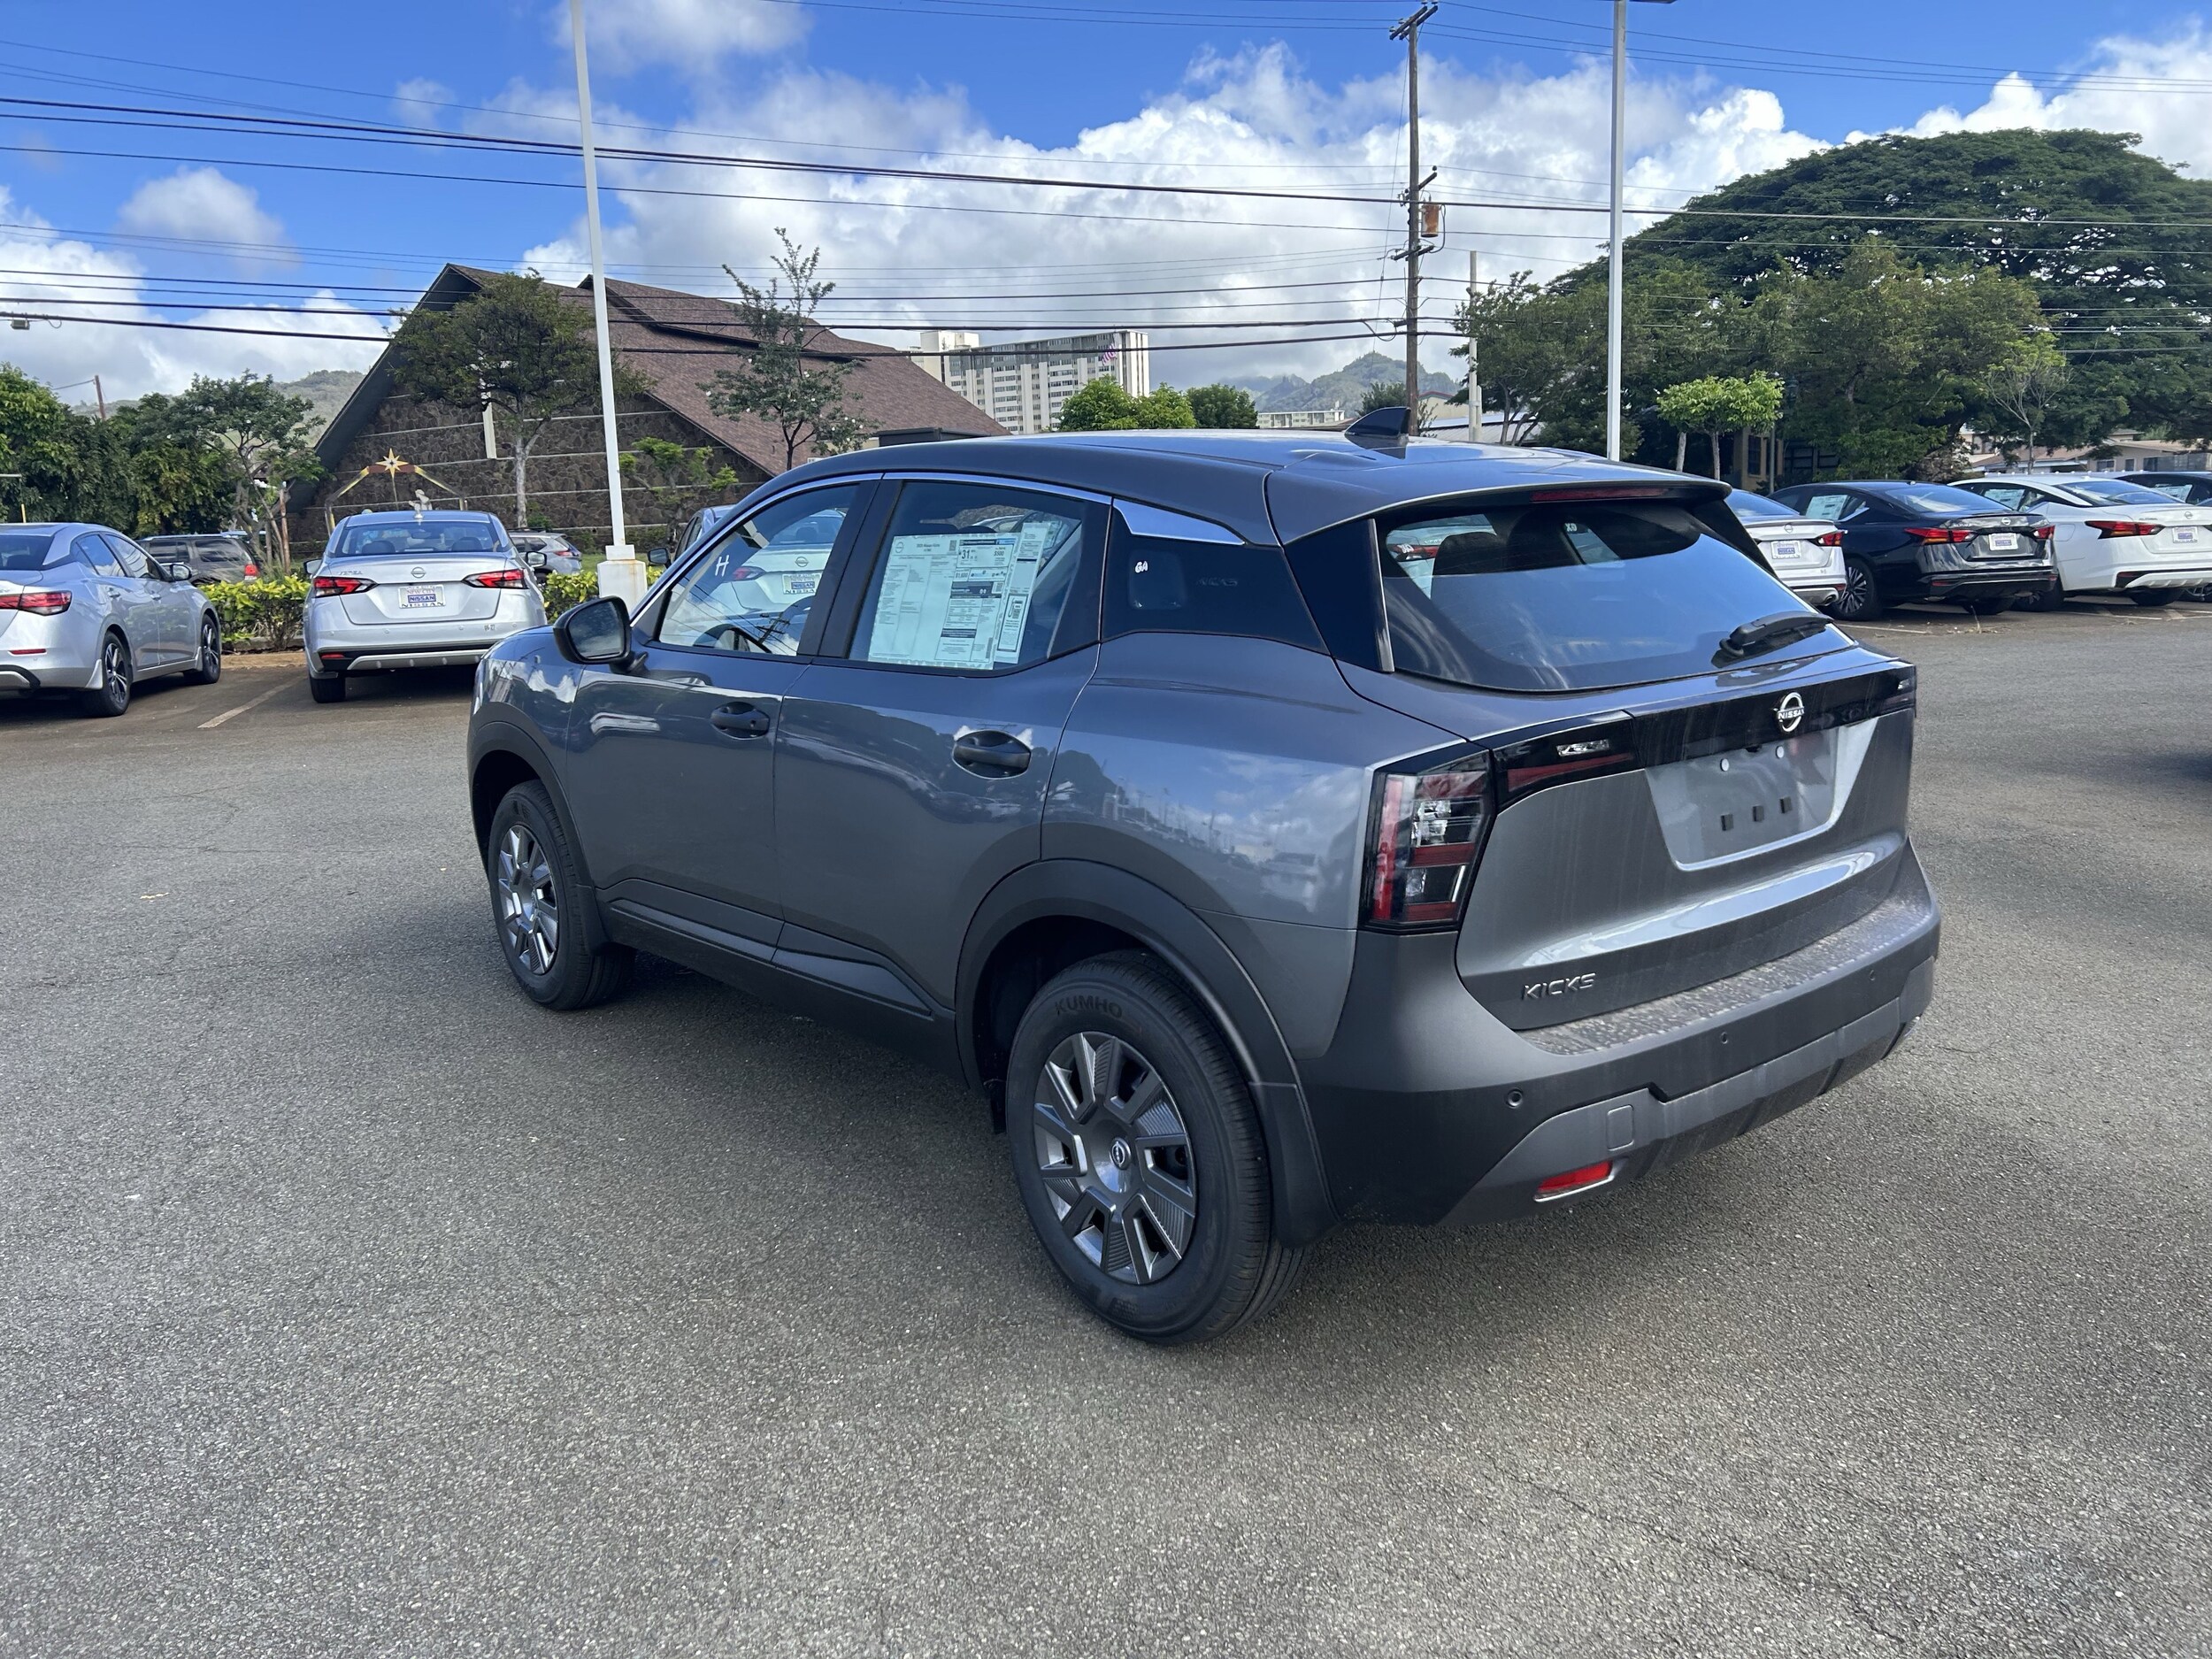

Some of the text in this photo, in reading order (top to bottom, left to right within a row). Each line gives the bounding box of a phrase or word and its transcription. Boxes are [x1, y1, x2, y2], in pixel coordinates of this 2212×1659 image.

[961, 549, 970, 559] 31
[715, 555, 729, 577] H
[1778, 709, 1805, 719] NISSAN
[1522, 972, 1596, 1000] KICKS
[1055, 995, 1123, 1018] KUMHO
